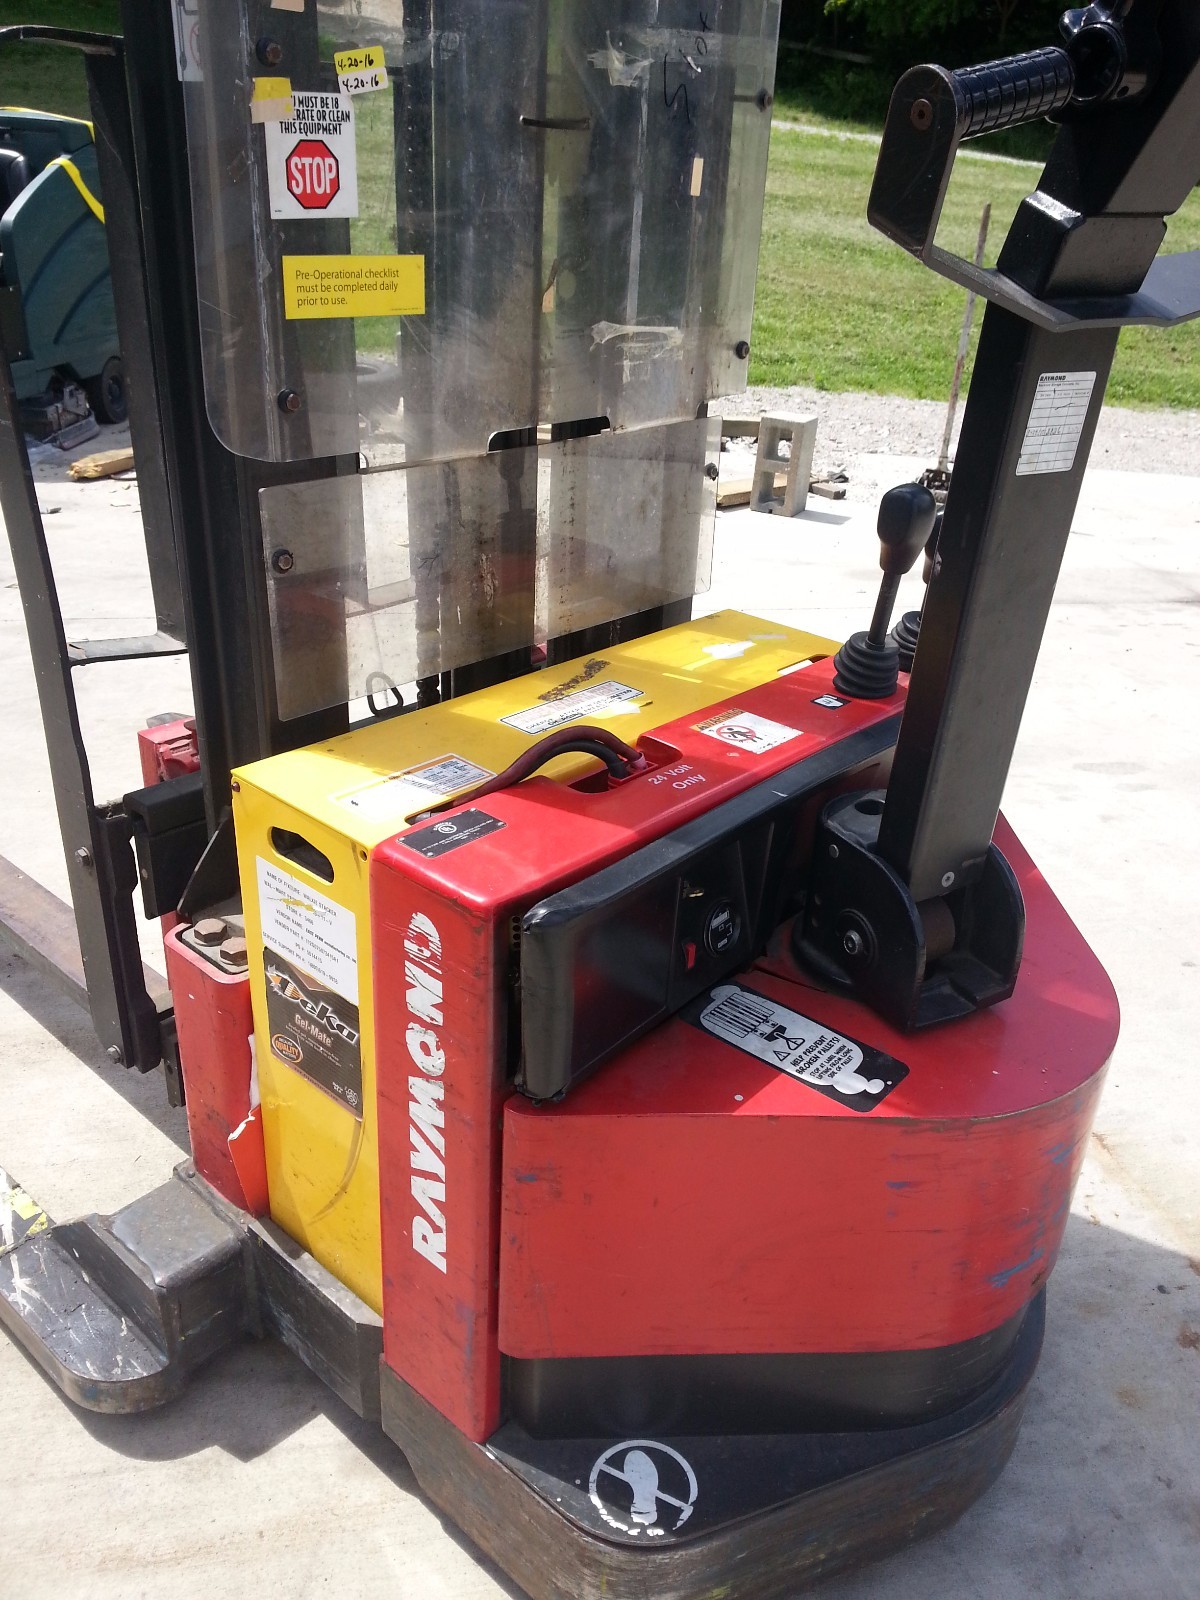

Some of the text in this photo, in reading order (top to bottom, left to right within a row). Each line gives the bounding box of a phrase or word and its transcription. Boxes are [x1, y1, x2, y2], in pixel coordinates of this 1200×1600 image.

[338, 54, 374, 71] 4-20-16
[298, 96, 318, 108] MUST
[320, 96, 329, 109] BE
[331, 97, 339, 109] 18
[316, 109, 327, 122] OR
[328, 110, 351, 122] CLEAN
[279, 121, 342, 136] THIS EQUIPMENT
[290, 156, 337, 195] STOP
[295, 268, 399, 281] Pre-Operational checklist
[296, 281, 398, 293] must be completed daily
[297, 297, 348, 308] prior to use.
[648, 764, 693, 785] 24 Volt
[672, 774, 706, 789] Only
[276, 1040, 298, 1057] QUALITY
[790, 1035, 828, 1067] HELP PREVENT
[795, 1036, 841, 1075] BROKEN PALLETS!
[404, 912, 447, 1274] RAYMOND
